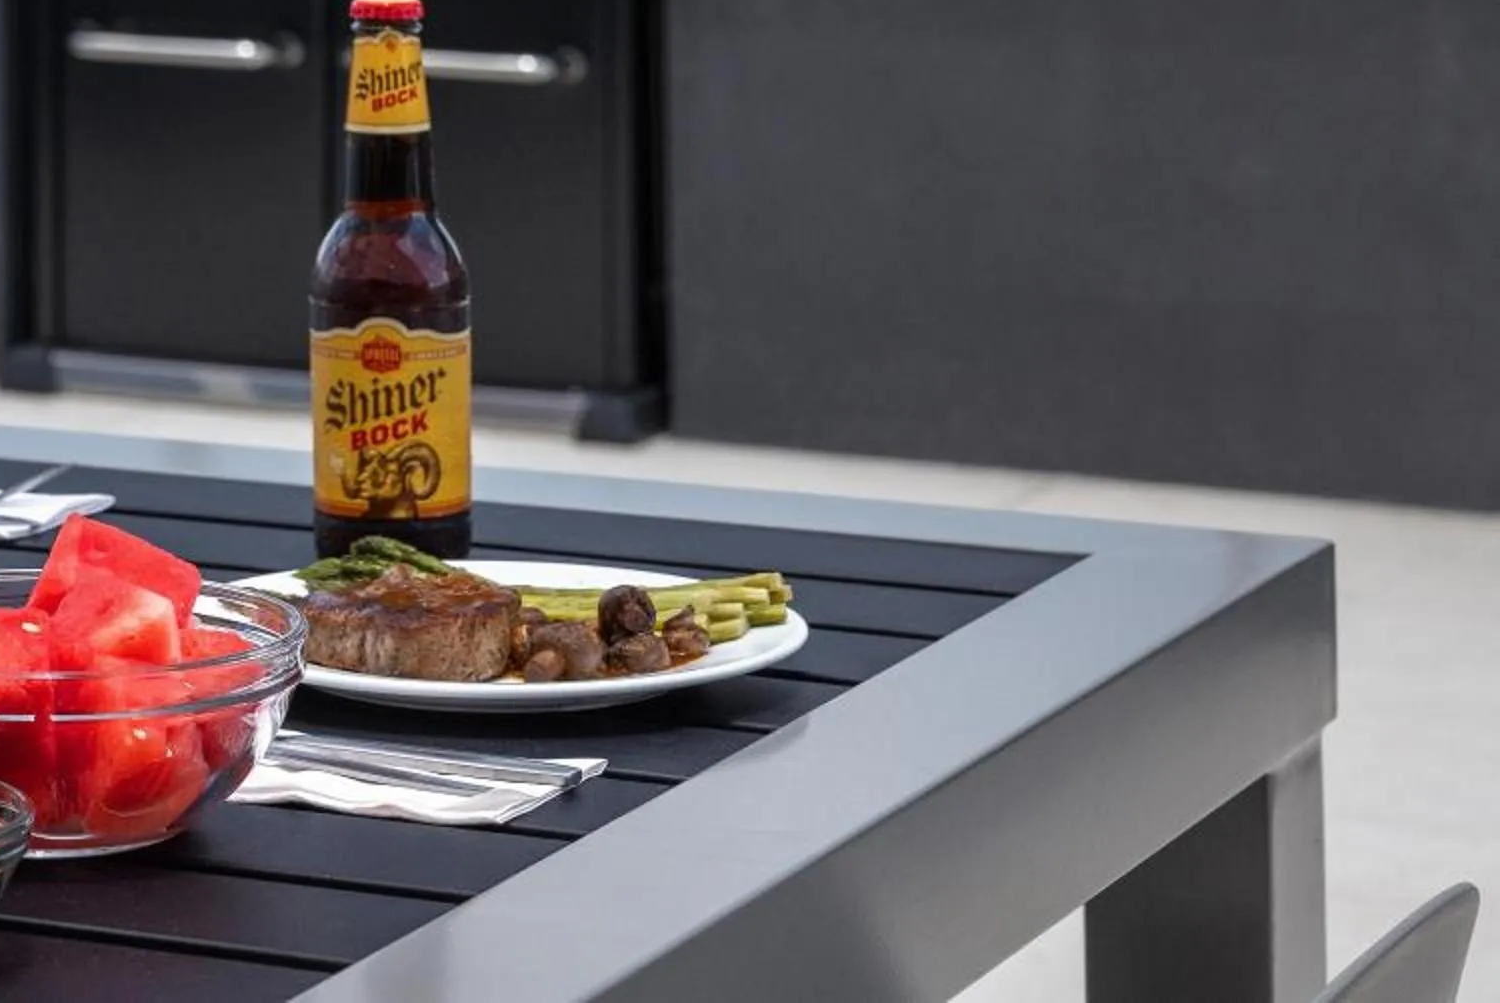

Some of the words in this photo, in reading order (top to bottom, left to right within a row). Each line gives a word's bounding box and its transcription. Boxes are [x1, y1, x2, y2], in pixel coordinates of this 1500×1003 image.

[355, 62, 421, 101] Shiner
[372, 86, 418, 113] BOCK
[325, 367, 447, 431] Shiner
[351, 410, 429, 450] BOCK
